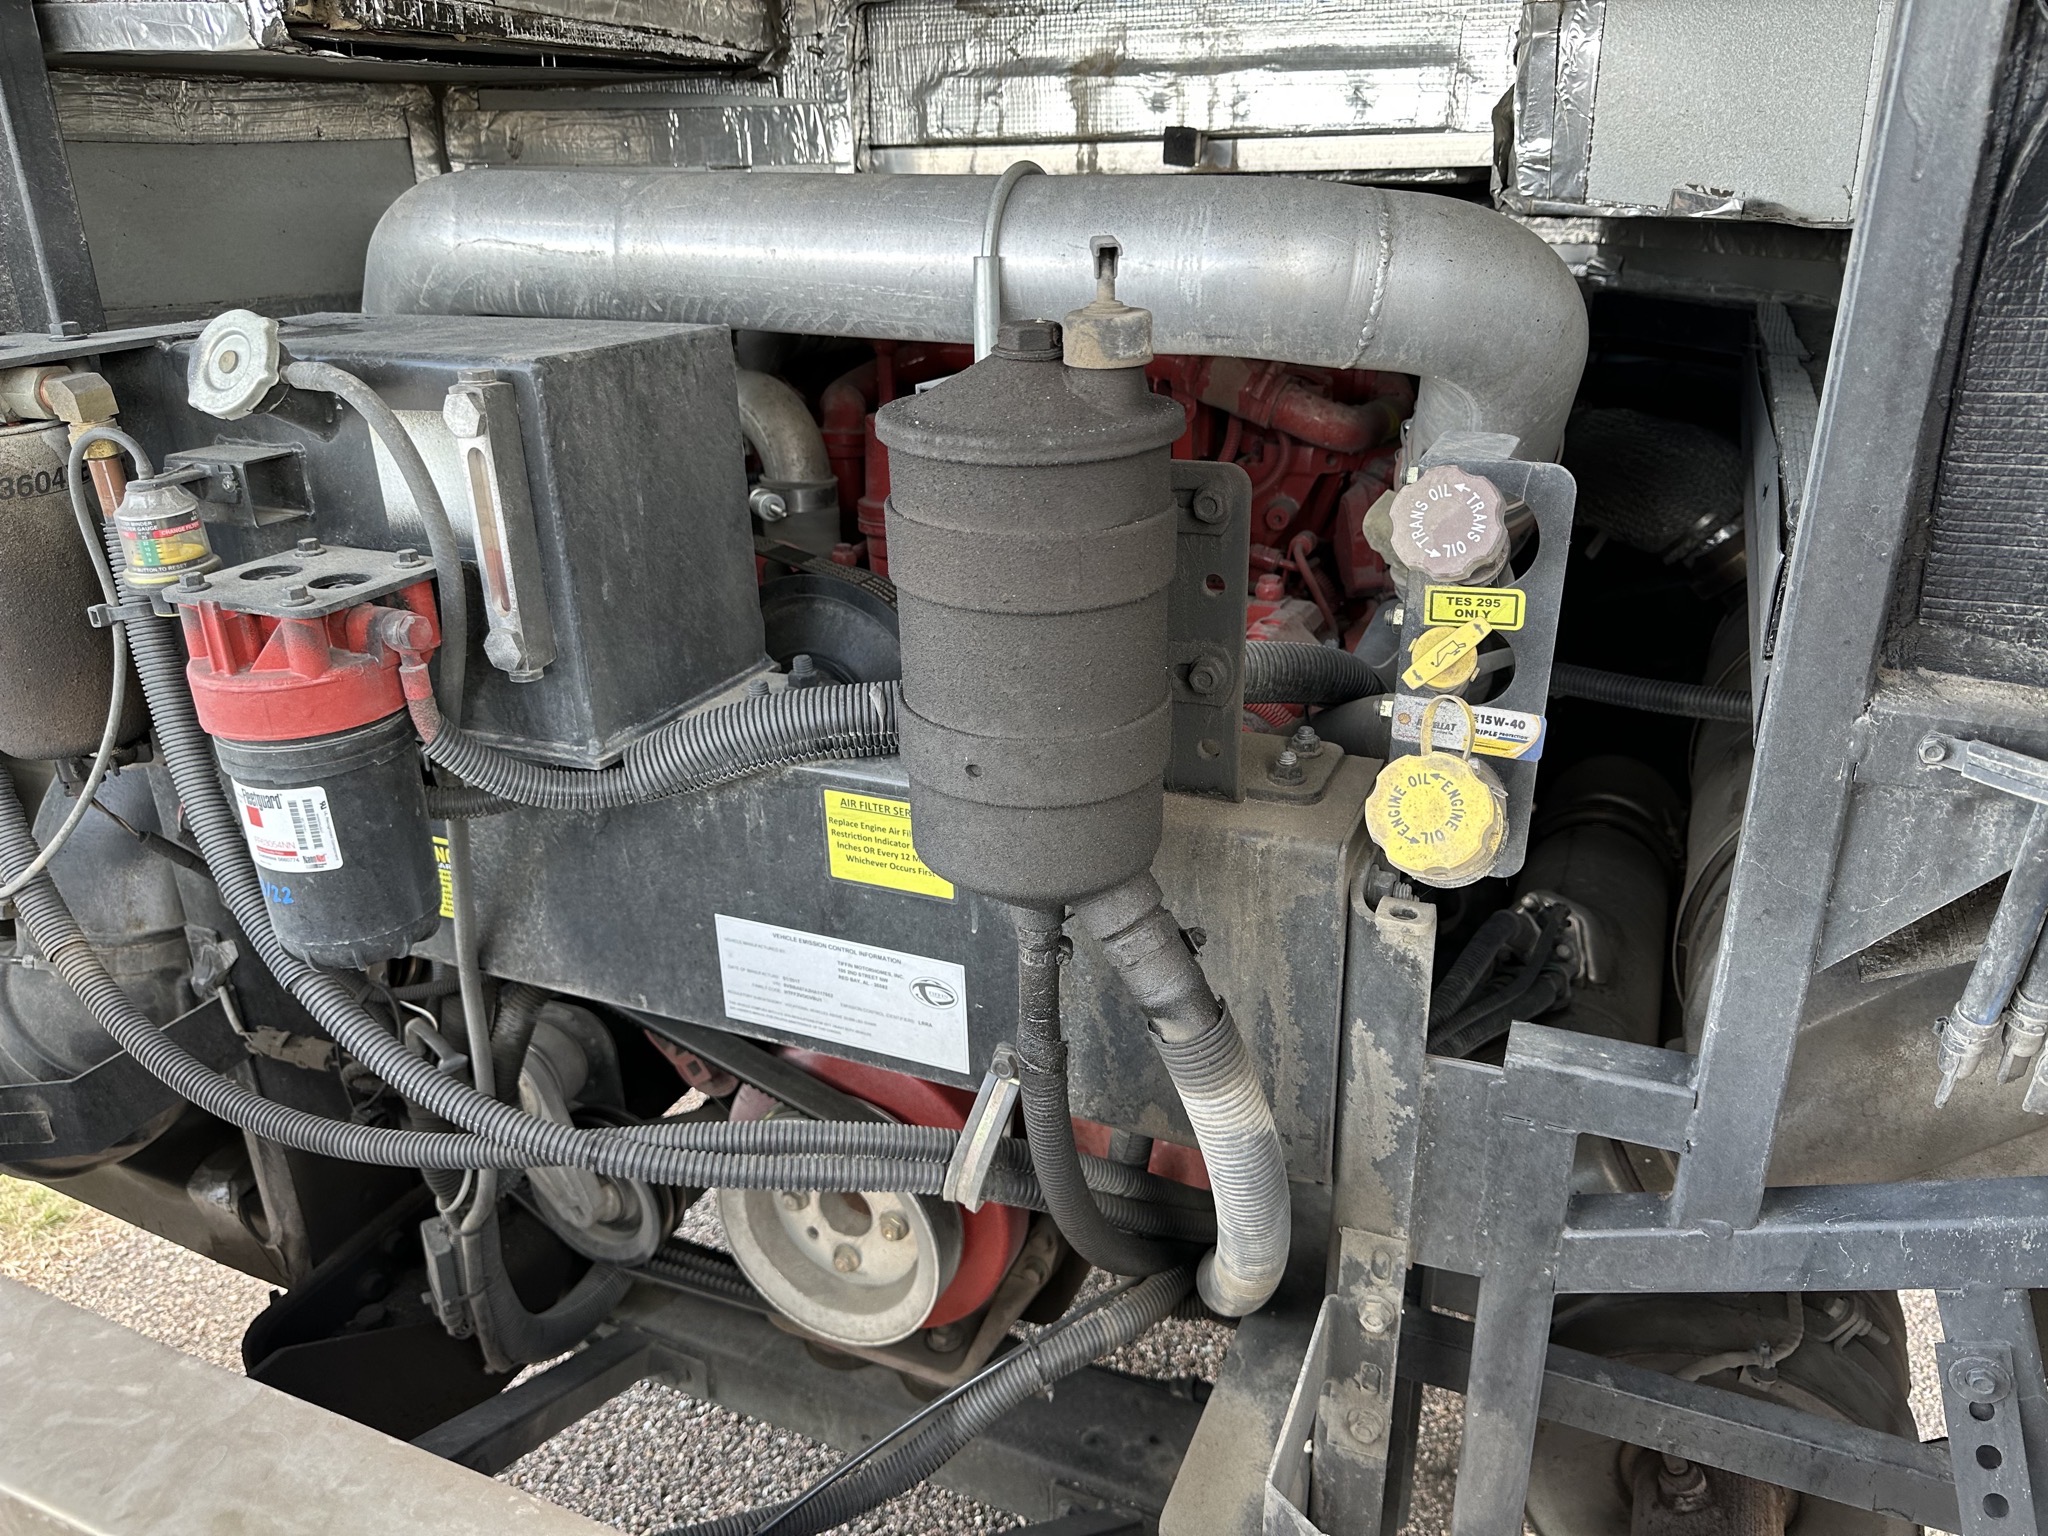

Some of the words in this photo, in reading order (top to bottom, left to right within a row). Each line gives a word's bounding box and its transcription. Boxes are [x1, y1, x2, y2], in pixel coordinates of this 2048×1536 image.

[1409, 500, 1429, 549] TRANS
[1428, 483, 1453, 501] OIL
[1466, 492, 1488, 543] TRANS
[161, 527, 185, 536] CHANGE
[1442, 540, 1467, 557] OIL
[168, 563, 188, 571] RESET
[1446, 596, 1472, 607] TES
[1476, 598, 1501, 608] 295
[1454, 608, 1492, 619] ONLY
[1480, 714, 1526, 730] 15W-40
[1475, 728, 1498, 738] RIPLE
[840, 798, 857, 808] AIR
[859, 800, 891, 814] FILTER
[893, 806, 911, 818] SER
[1388, 786, 1411, 837] ENGINE
[1408, 773, 1431, 788] OIL
[1440, 780, 1464, 832] ENGINE
[829, 816, 858, 829] Replace
[860, 822, 886, 833] Engine
[888, 827, 900, 837] Air
[902, 829, 911, 838] Fil
[831, 829, 872, 843] Restriction
[874, 836, 910, 849] Indicator
[1421, 831, 1444, 845] OIL
[837, 841, 861, 853] Inches
[863, 846, 875, 855] OR
[877, 848, 899, 860] Every
[900, 853, 910, 861] 12
[846, 854, 887, 869] Whichever
[889, 862, 916, 874] Occurs
[918, 867, 936, 878] First
[772, 933, 797, 942] VEHICLE
[799, 938, 827, 949] EMISSION
[828, 943, 857, 956] CONTROL
[858, 950, 902, 964] INFORMATION
